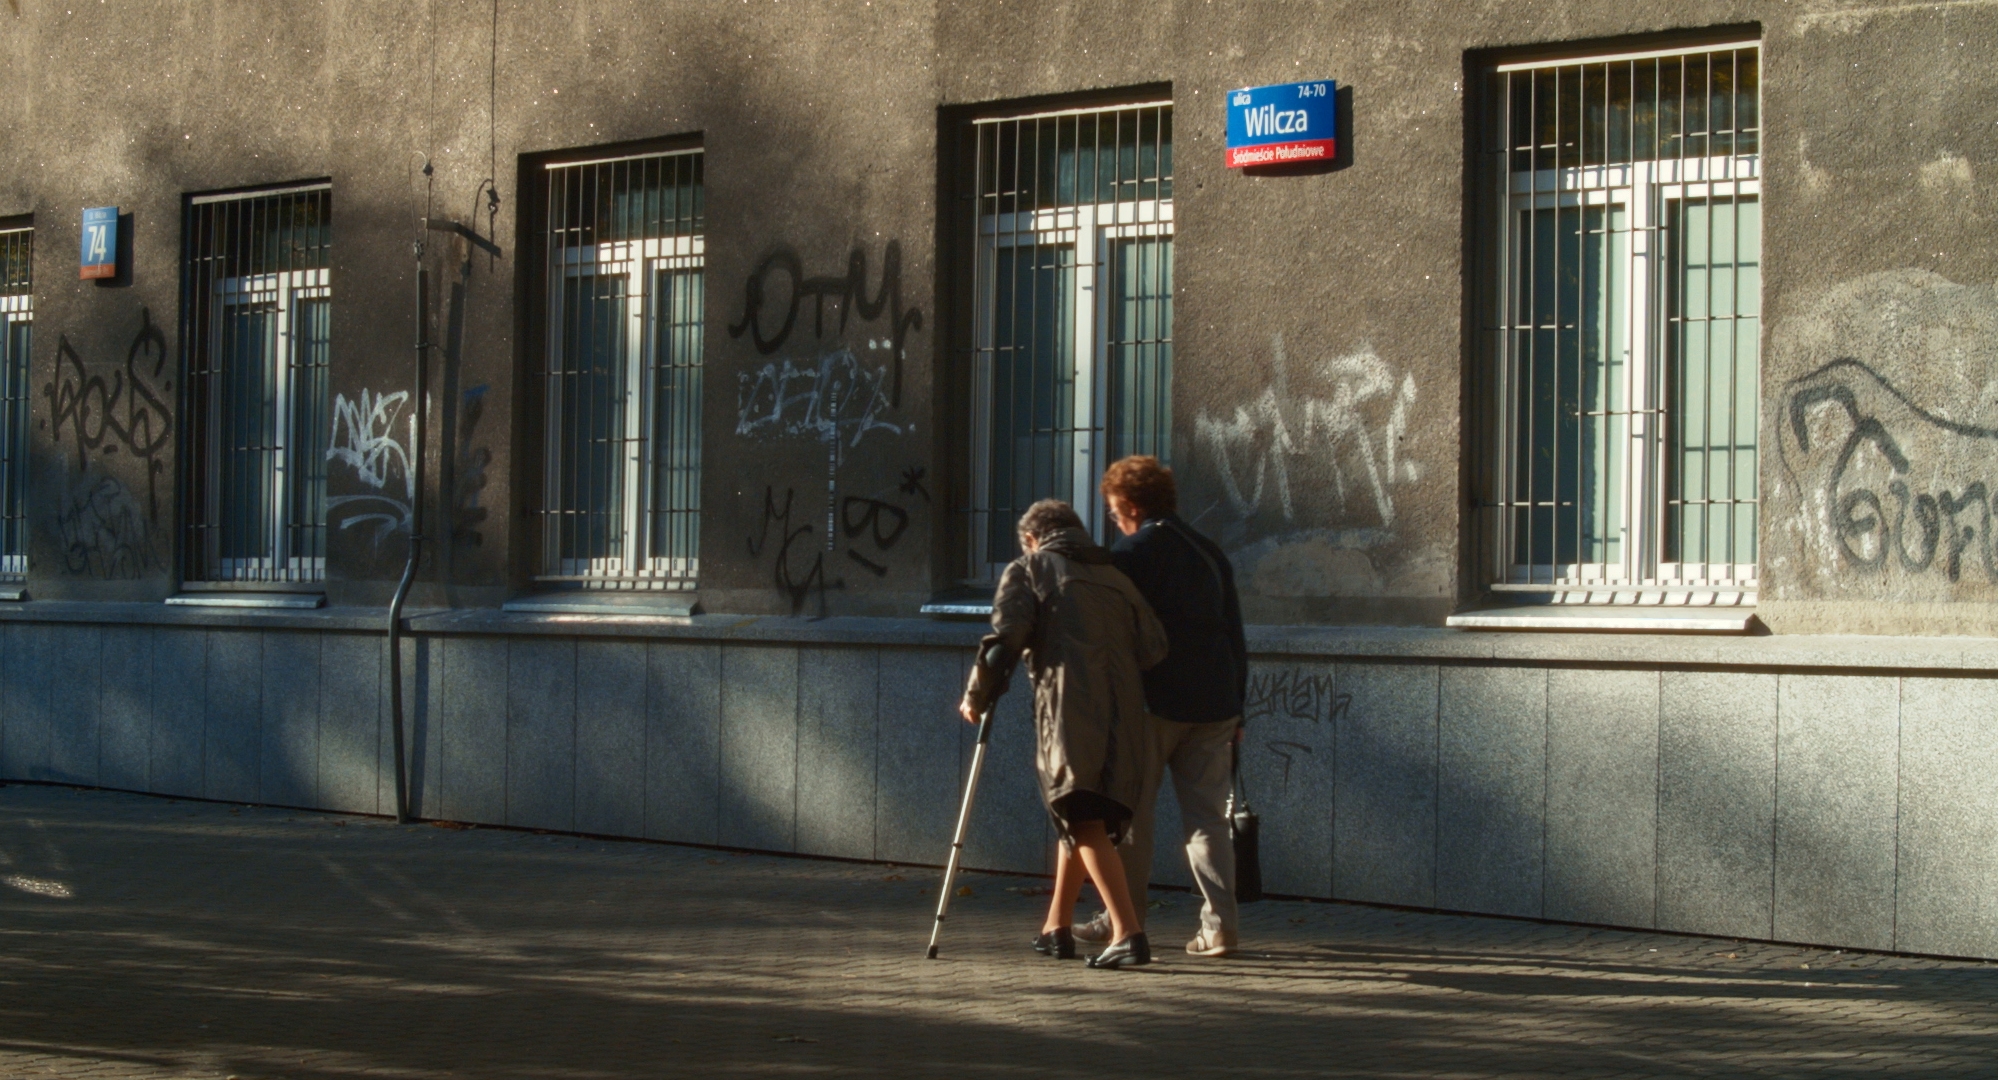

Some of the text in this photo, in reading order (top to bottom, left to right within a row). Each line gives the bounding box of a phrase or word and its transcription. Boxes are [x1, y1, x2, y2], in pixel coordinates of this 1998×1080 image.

[1233, 92, 1251, 106] ulica
[1298, 83, 1326, 99] 74-70
[1244, 103, 1308, 138] Wilcza
[1233, 144, 1325, 165] Śródmieście Południowe
[88, 224, 107, 262] 74
